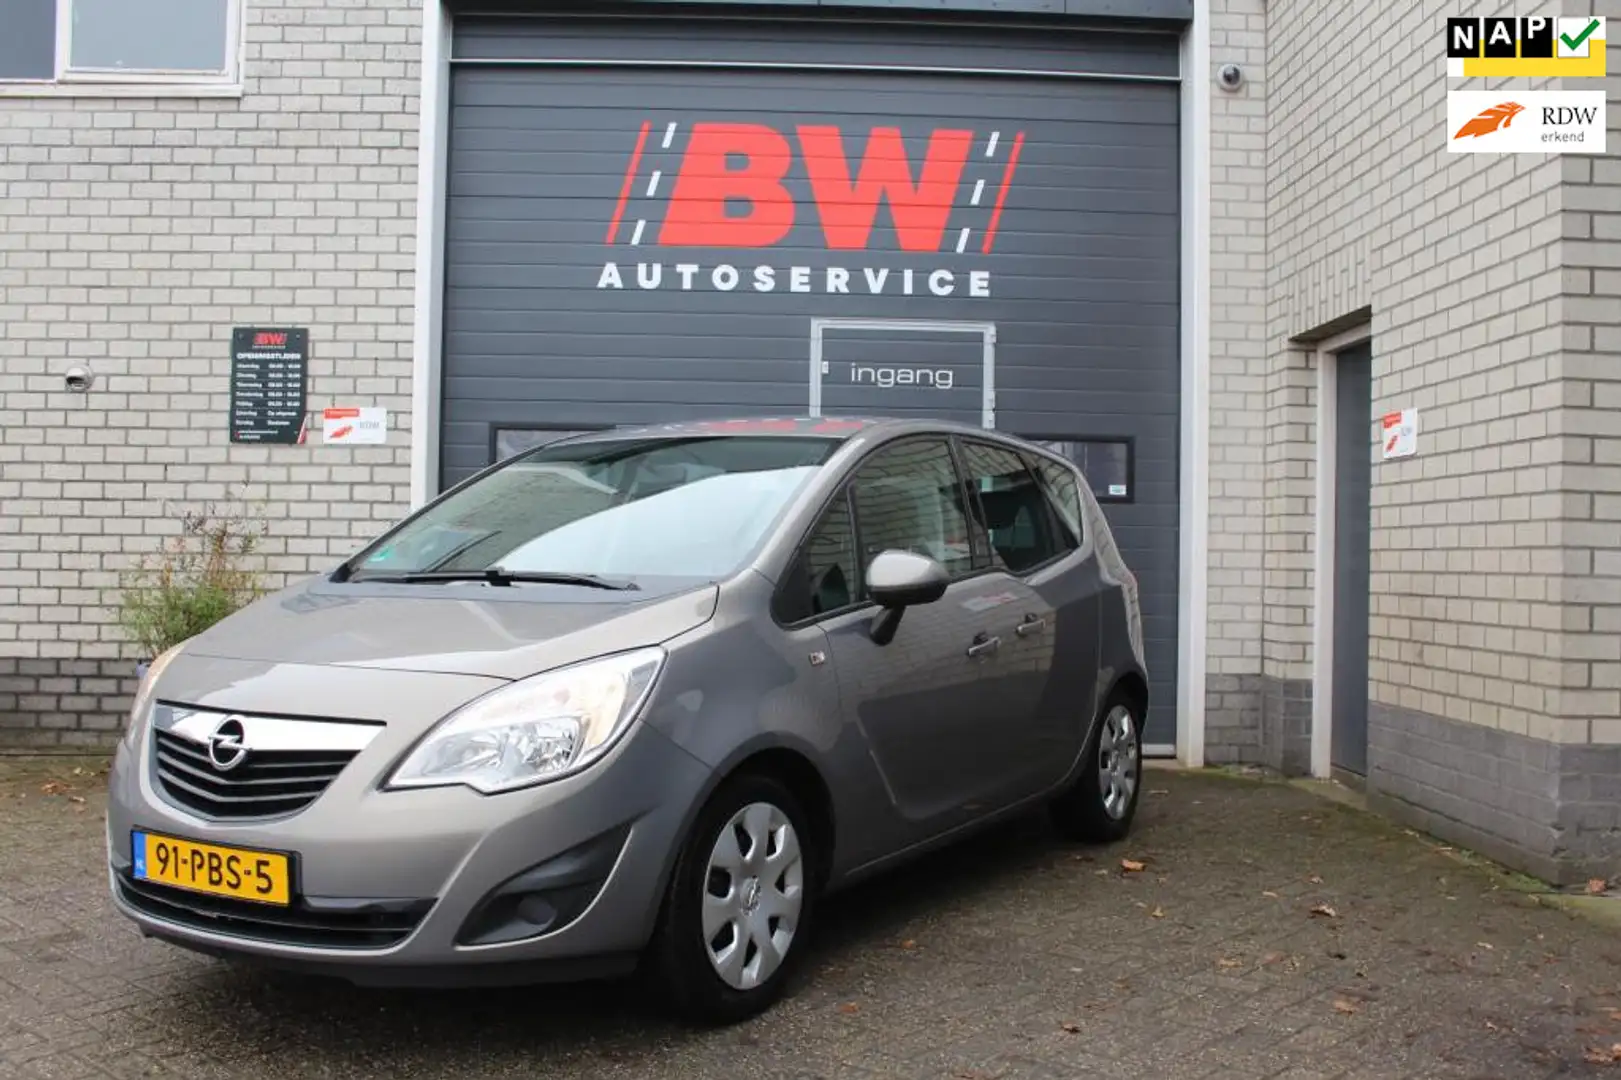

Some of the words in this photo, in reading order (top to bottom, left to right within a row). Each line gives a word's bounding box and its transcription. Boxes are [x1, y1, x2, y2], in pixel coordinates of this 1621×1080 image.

[657, 122, 975, 253] BW
[597, 262, 991, 297] AUTOSERVICE
[850, 361, 954, 390] ingang
[155, 842, 274, 895] 91-PBS-5
